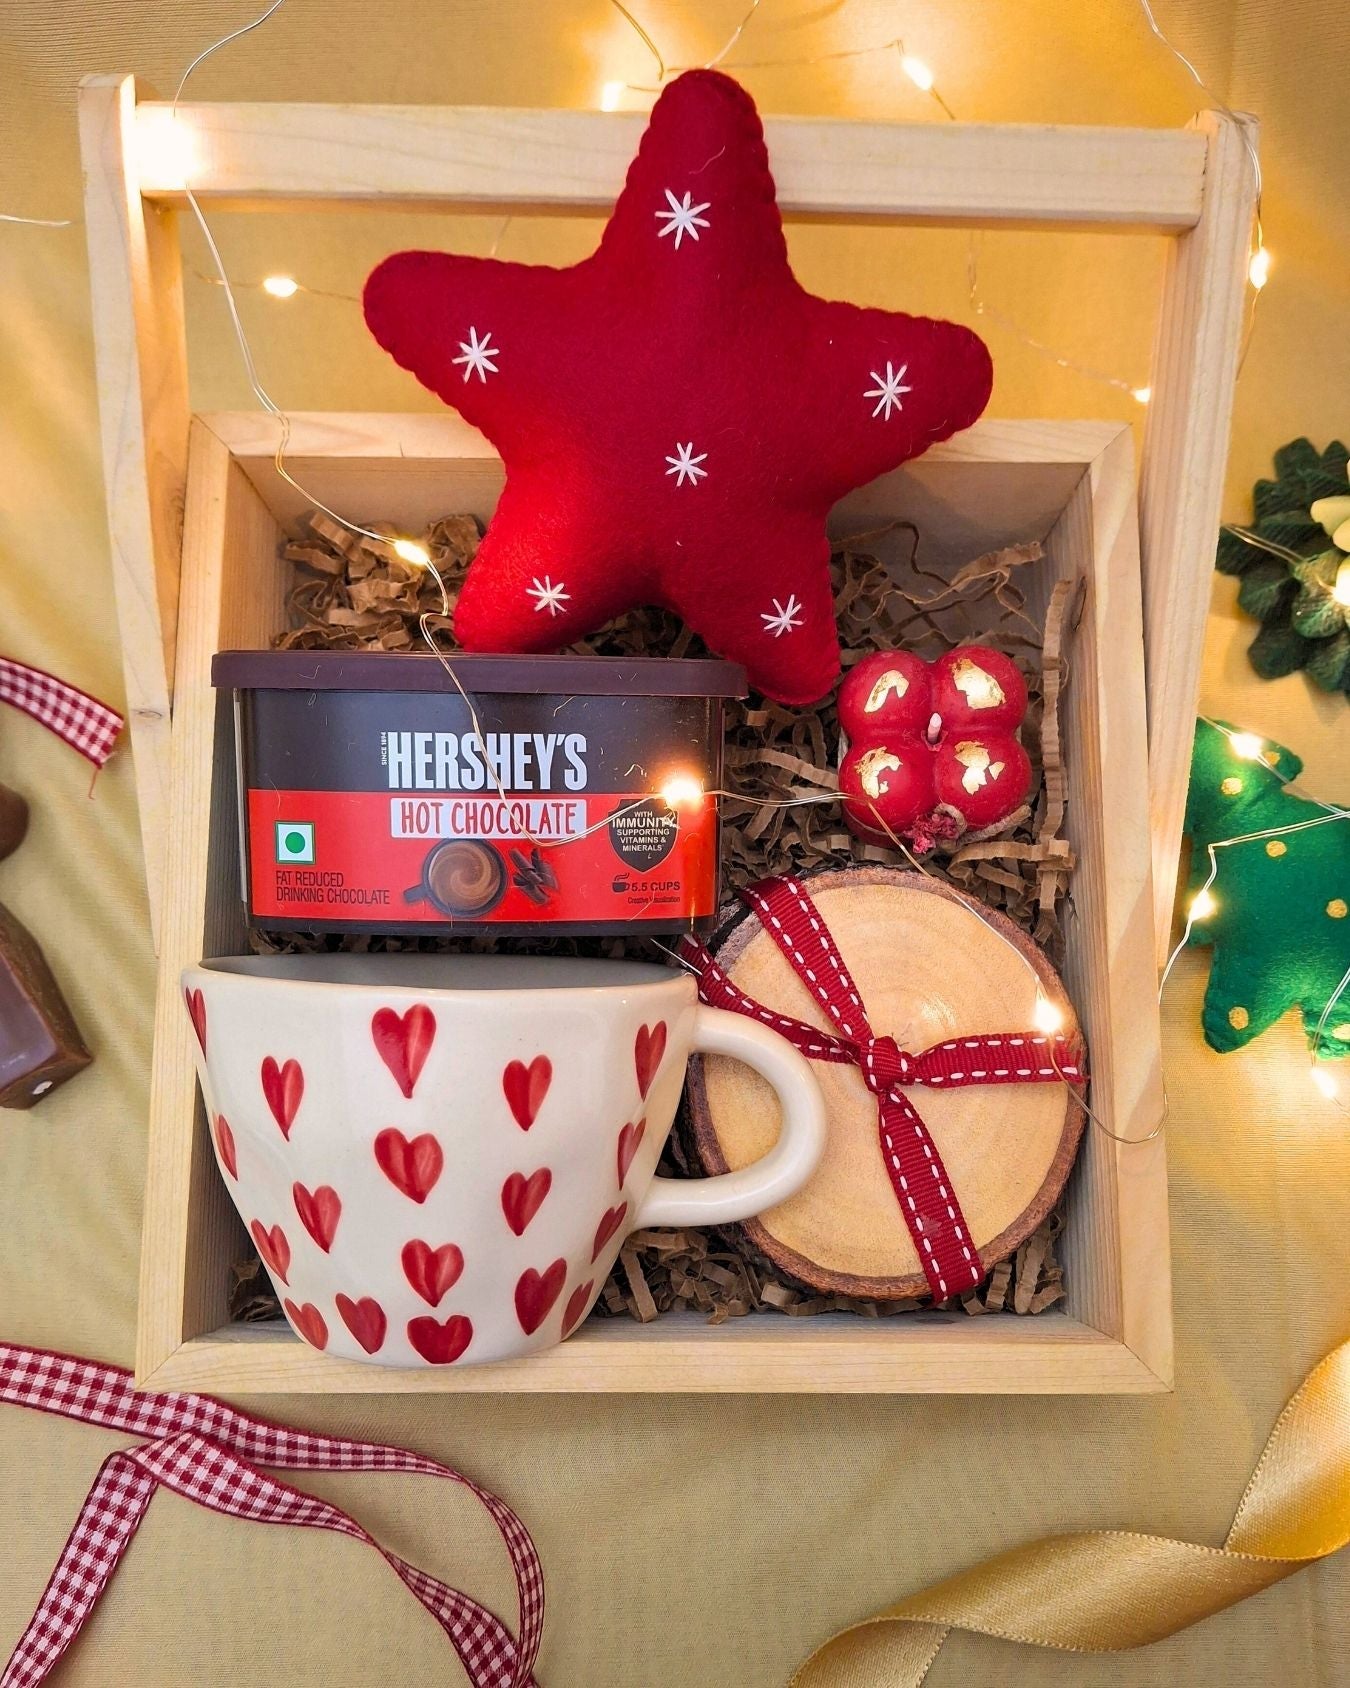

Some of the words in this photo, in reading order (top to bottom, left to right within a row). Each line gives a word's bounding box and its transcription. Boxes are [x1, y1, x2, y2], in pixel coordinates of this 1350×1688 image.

[380, 746, 388, 766] SINCE
[387, 731, 588, 791] HERSHEY'S
[401, 801, 444, 834] HOT
[451, 801, 578, 835] CHOCOLATE
[616, 828, 670, 836] SUPPORTING
[620, 836, 659, 844] VITAMINS
[660, 836, 667, 844] &
[622, 844, 662, 852] MINERALS
[275, 870, 292, 886] FAT
[295, 871, 344, 888] REDUCED
[631, 882, 648, 892] 5.5
[650, 881, 681, 891] CUPS
[276, 886, 324, 903] DRINKING
[326, 888, 391, 905] CHOCOLATE
